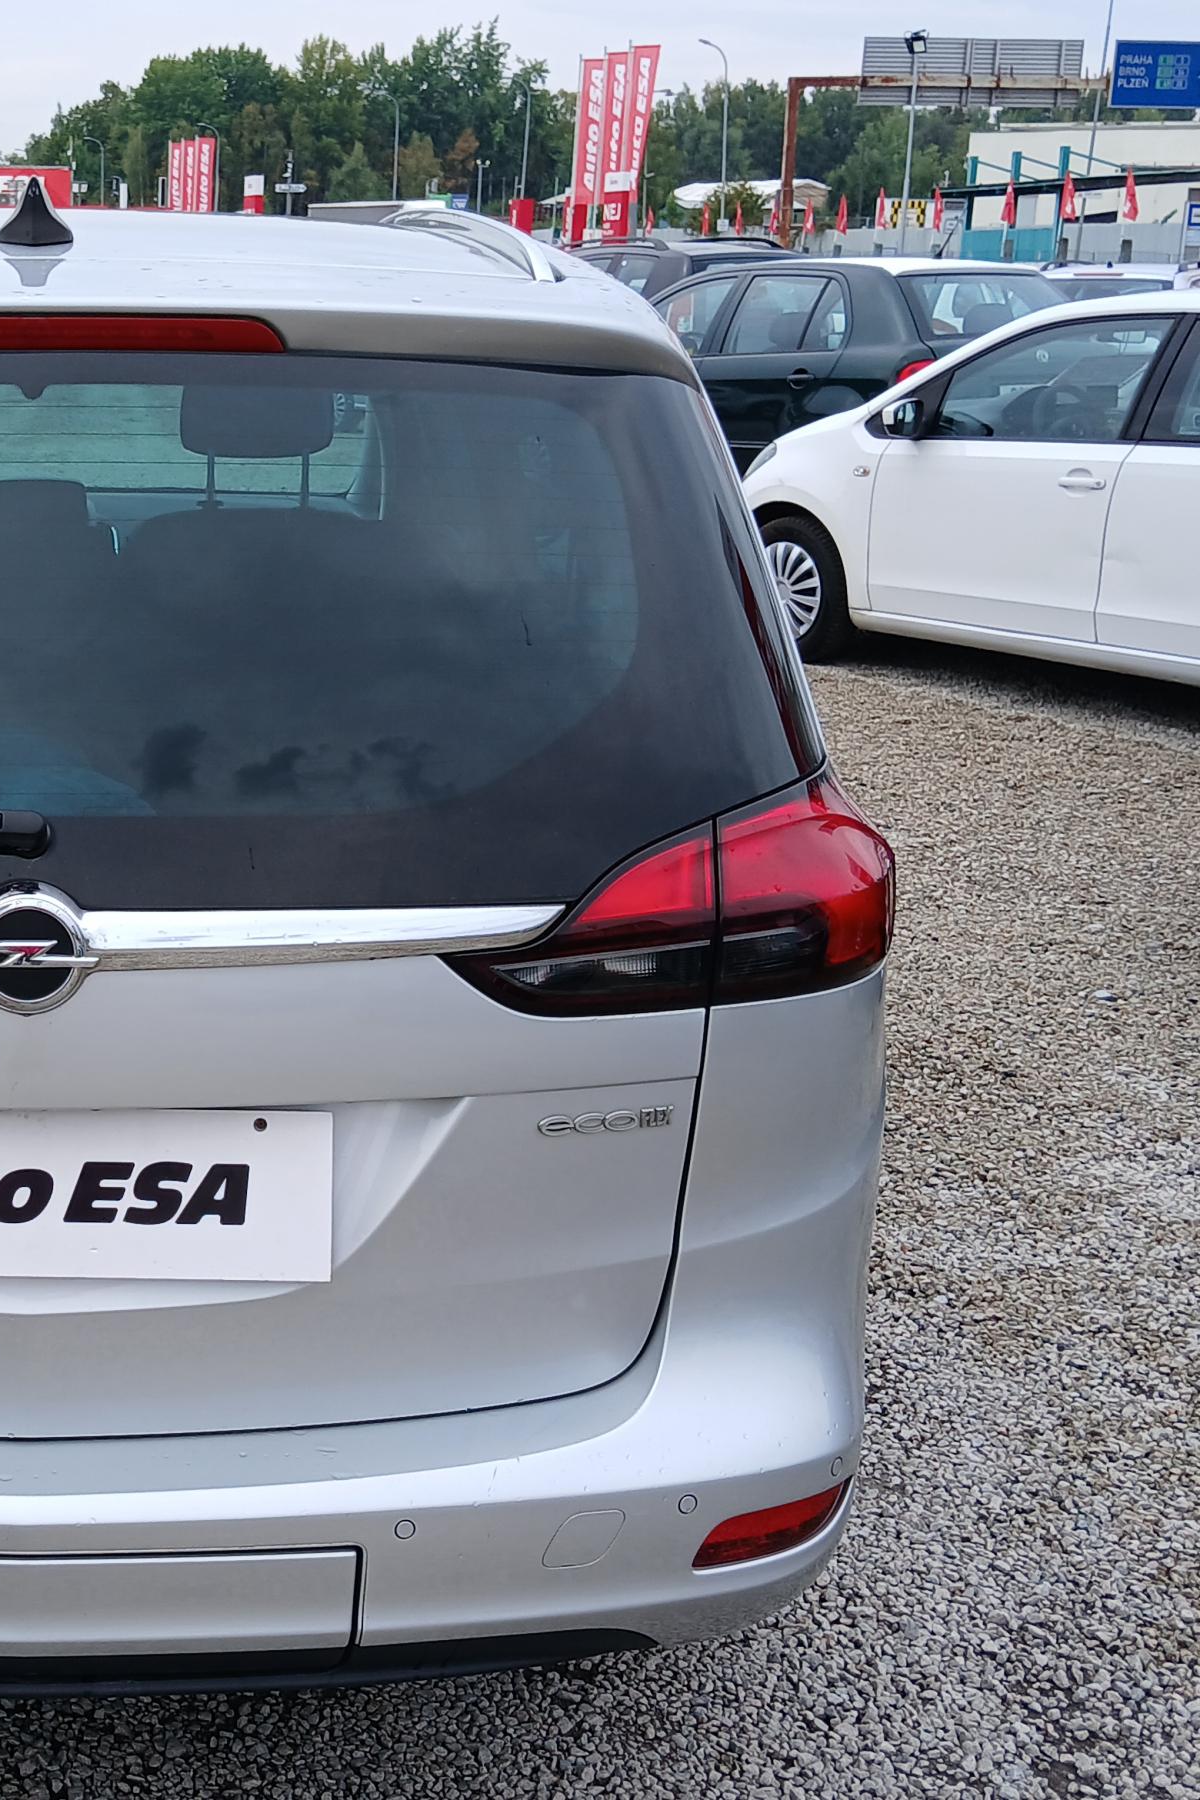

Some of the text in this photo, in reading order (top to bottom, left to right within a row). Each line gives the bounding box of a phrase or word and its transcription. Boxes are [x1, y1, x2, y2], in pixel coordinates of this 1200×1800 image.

[1119, 66, 1146, 77] BRNO
[1120, 54, 1153, 65] PRAHA
[612, 64, 626, 118] ESA
[637, 58, 651, 113] ESA
[1117, 76, 1150, 88] PLZEŇ
[63, 1161, 250, 1226] ESA
